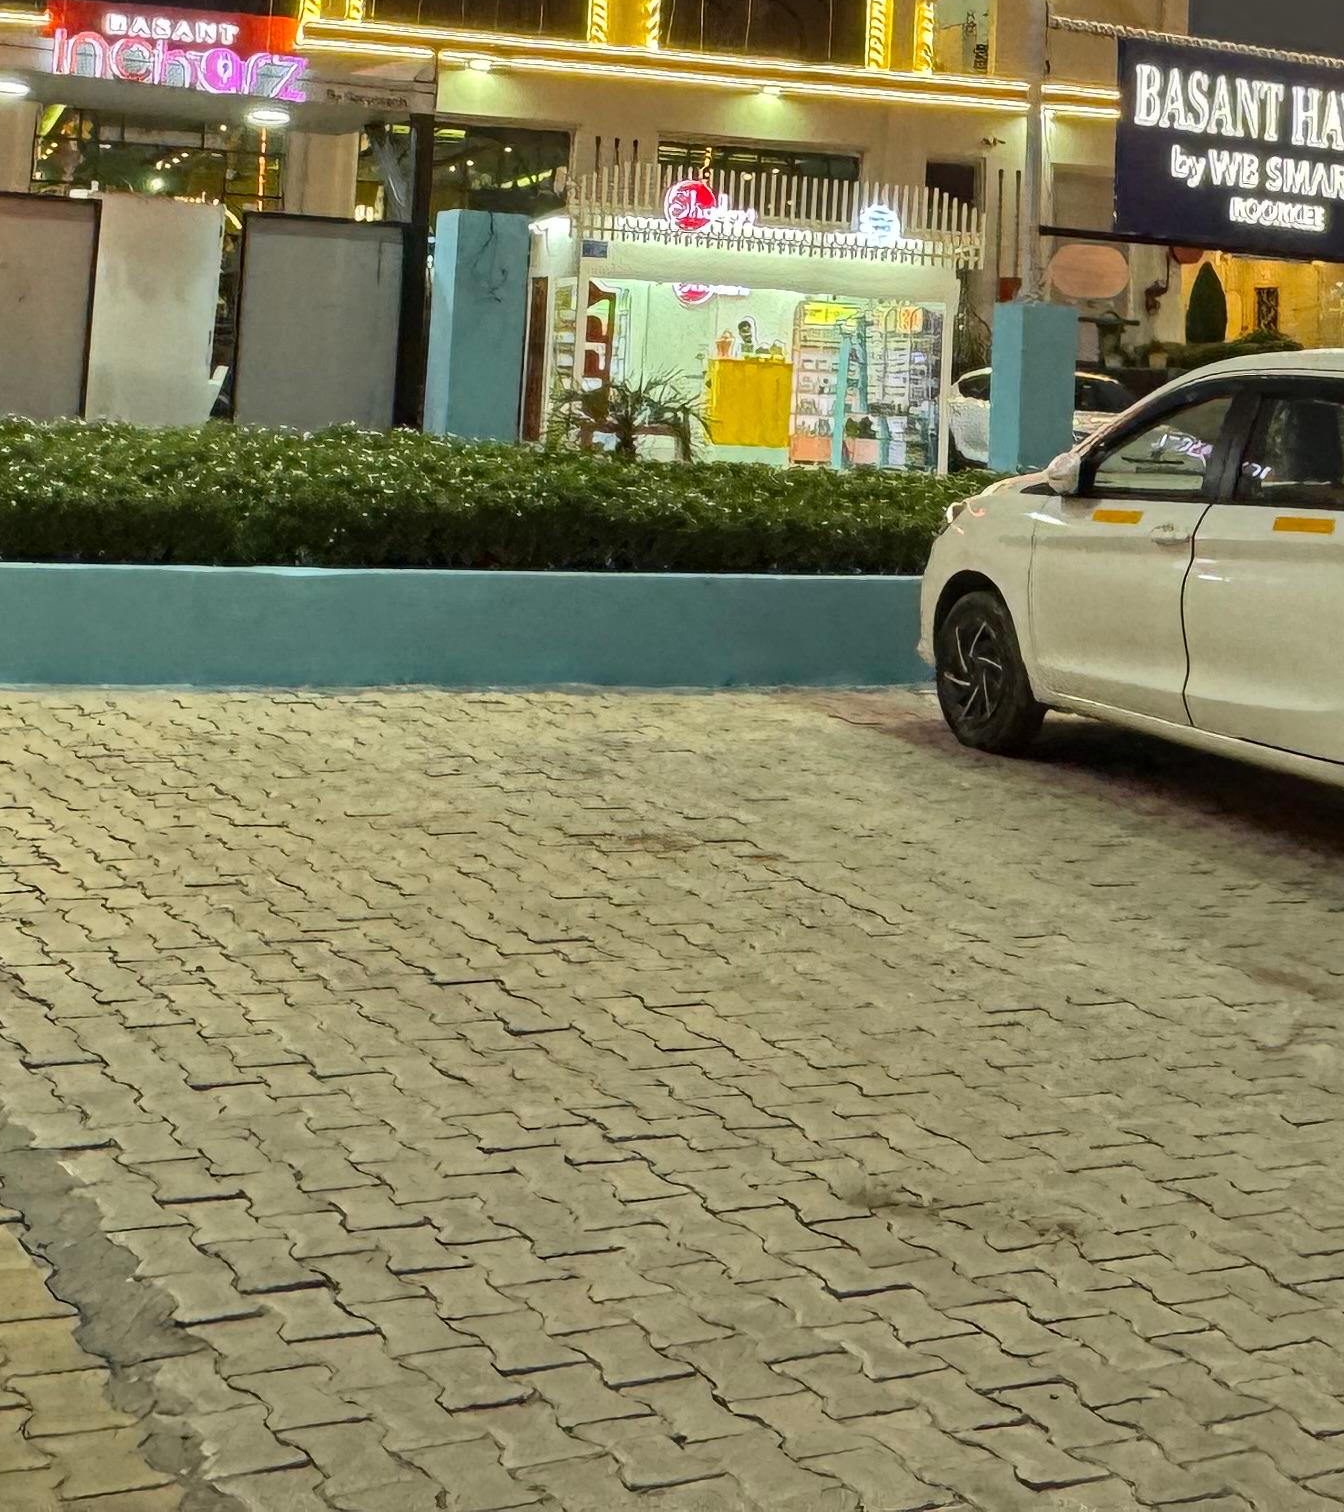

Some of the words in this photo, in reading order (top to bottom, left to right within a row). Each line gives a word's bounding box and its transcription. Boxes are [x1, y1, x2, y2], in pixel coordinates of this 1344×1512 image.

[104, 12, 241, 46] BASANT
[1133, 63, 1284, 142] BASANT
[1170, 144, 1205, 188] by
